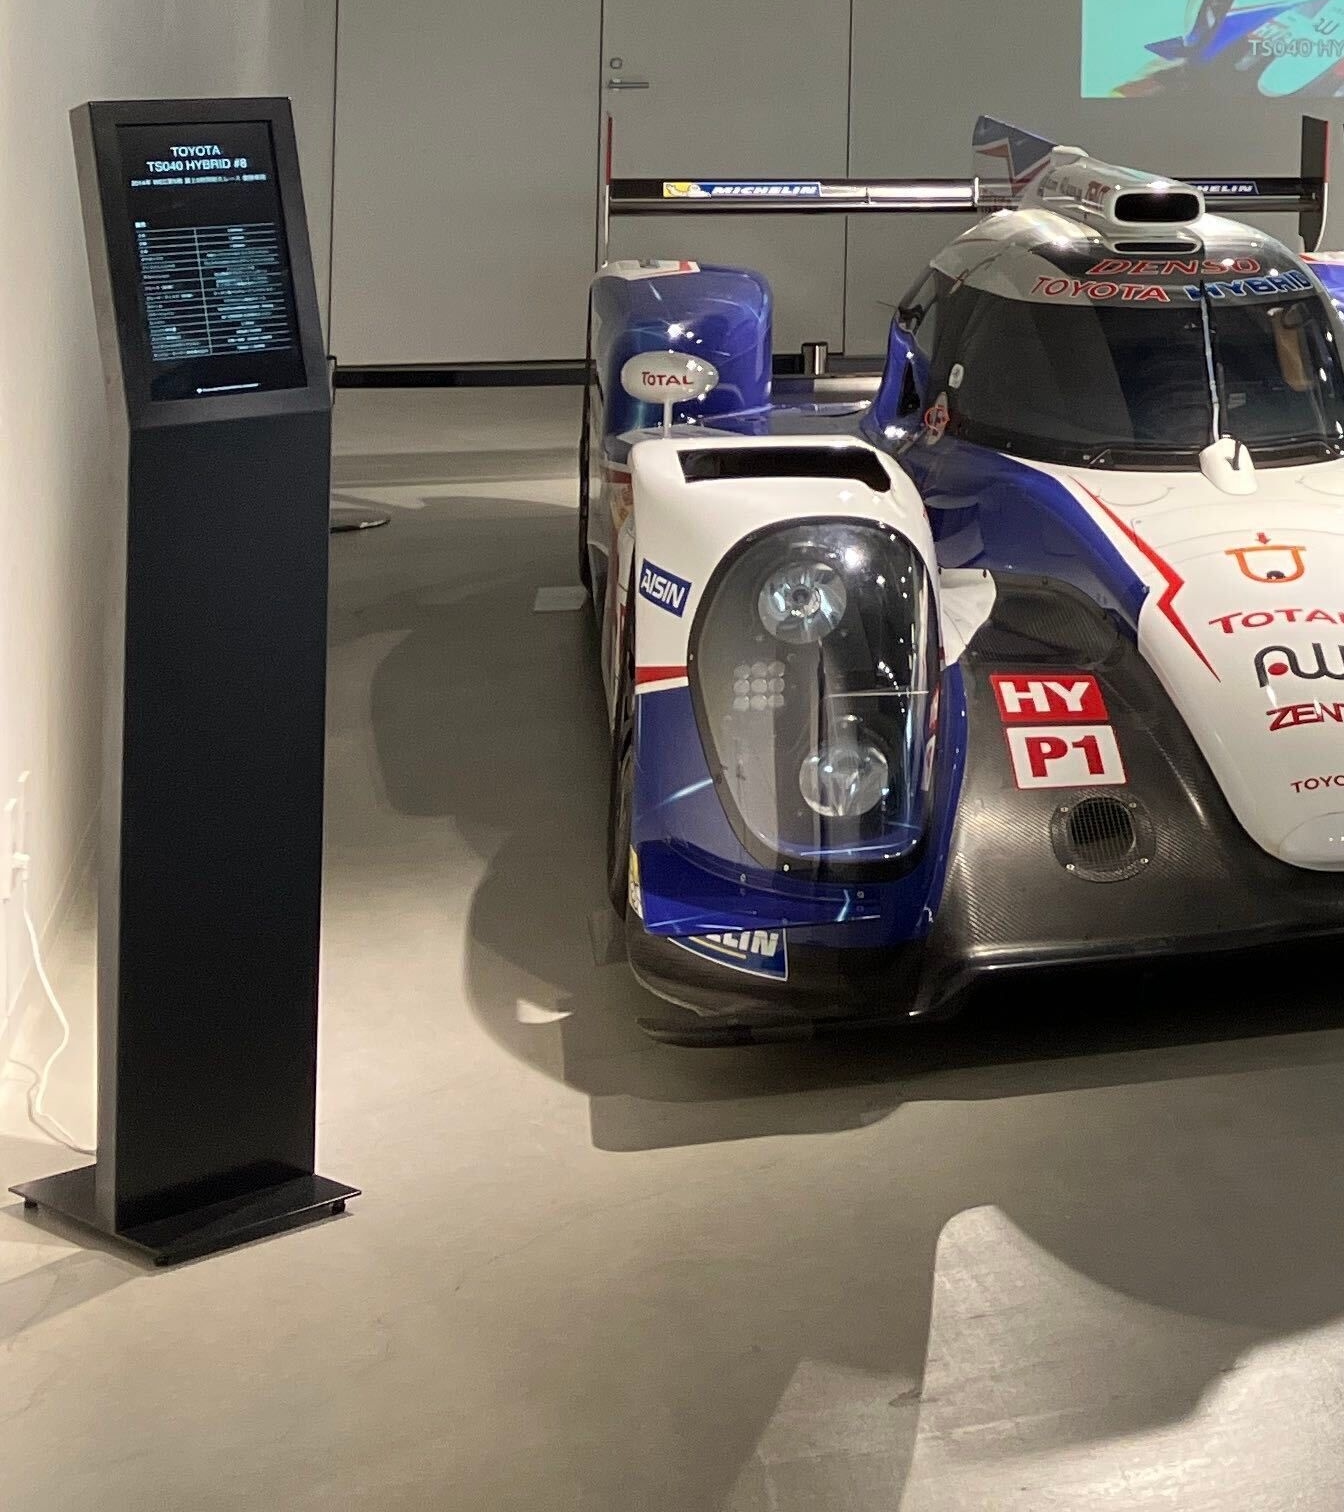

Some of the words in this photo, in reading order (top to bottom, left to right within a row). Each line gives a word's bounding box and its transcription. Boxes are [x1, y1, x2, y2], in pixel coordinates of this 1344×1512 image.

[169, 145, 222, 157] TOYOTA
[146, 160, 184, 173] TS040
[185, 158, 232, 171] HYBRID
[233, 157, 248, 169] #8
[711, 185, 819, 195] MICHELIN
[1086, 258, 1261, 276] DENSO
[1031, 276, 1171, 303] TOYOTA
[1182, 270, 1314, 302] HYBRID
[641, 370, 695, 386] TOTAL
[640, 568, 685, 609] AISIN
[998, 681, 1091, 713] HY
[1024, 735, 1106, 778] P1
